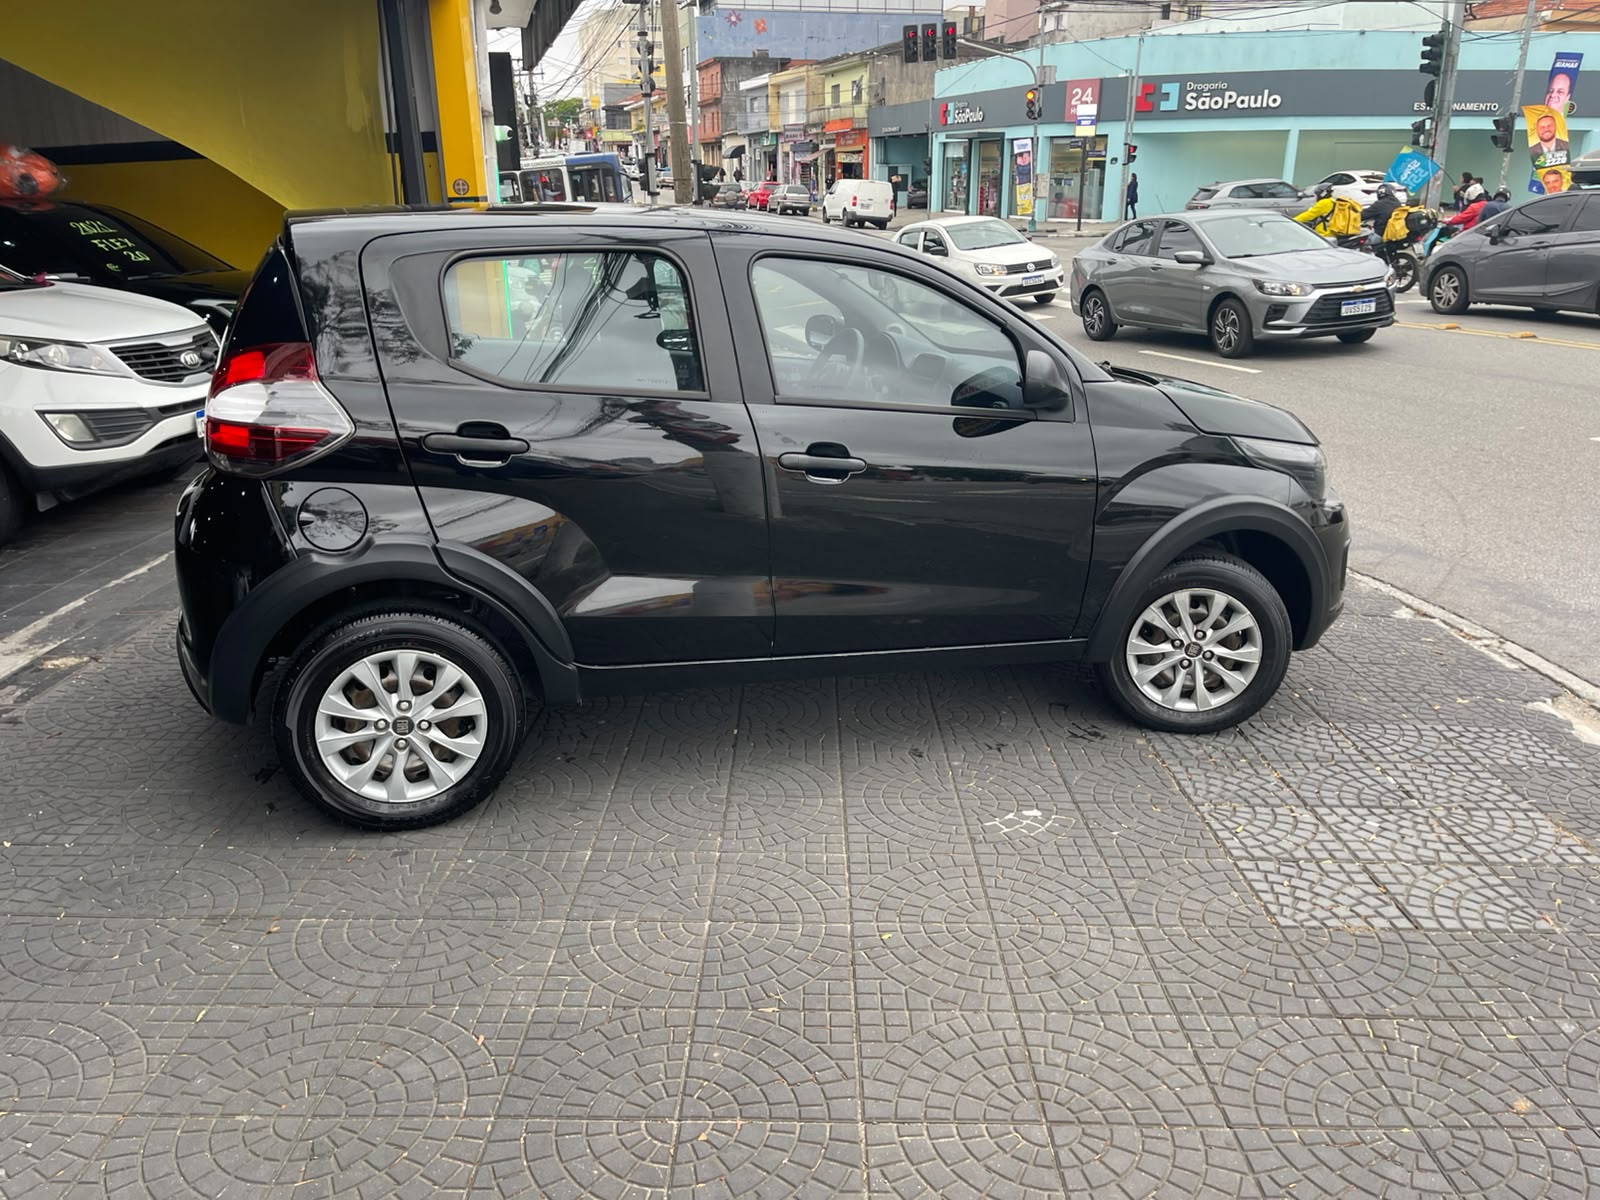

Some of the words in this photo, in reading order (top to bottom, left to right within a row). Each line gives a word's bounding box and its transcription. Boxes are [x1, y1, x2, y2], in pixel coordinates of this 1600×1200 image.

[1186, 81, 1228, 91] Drogaria
[1071, 87, 1093, 106] 24
[1184, 89, 1282, 110] SãoPaulo
[90, 237, 136, 251] FLEX
